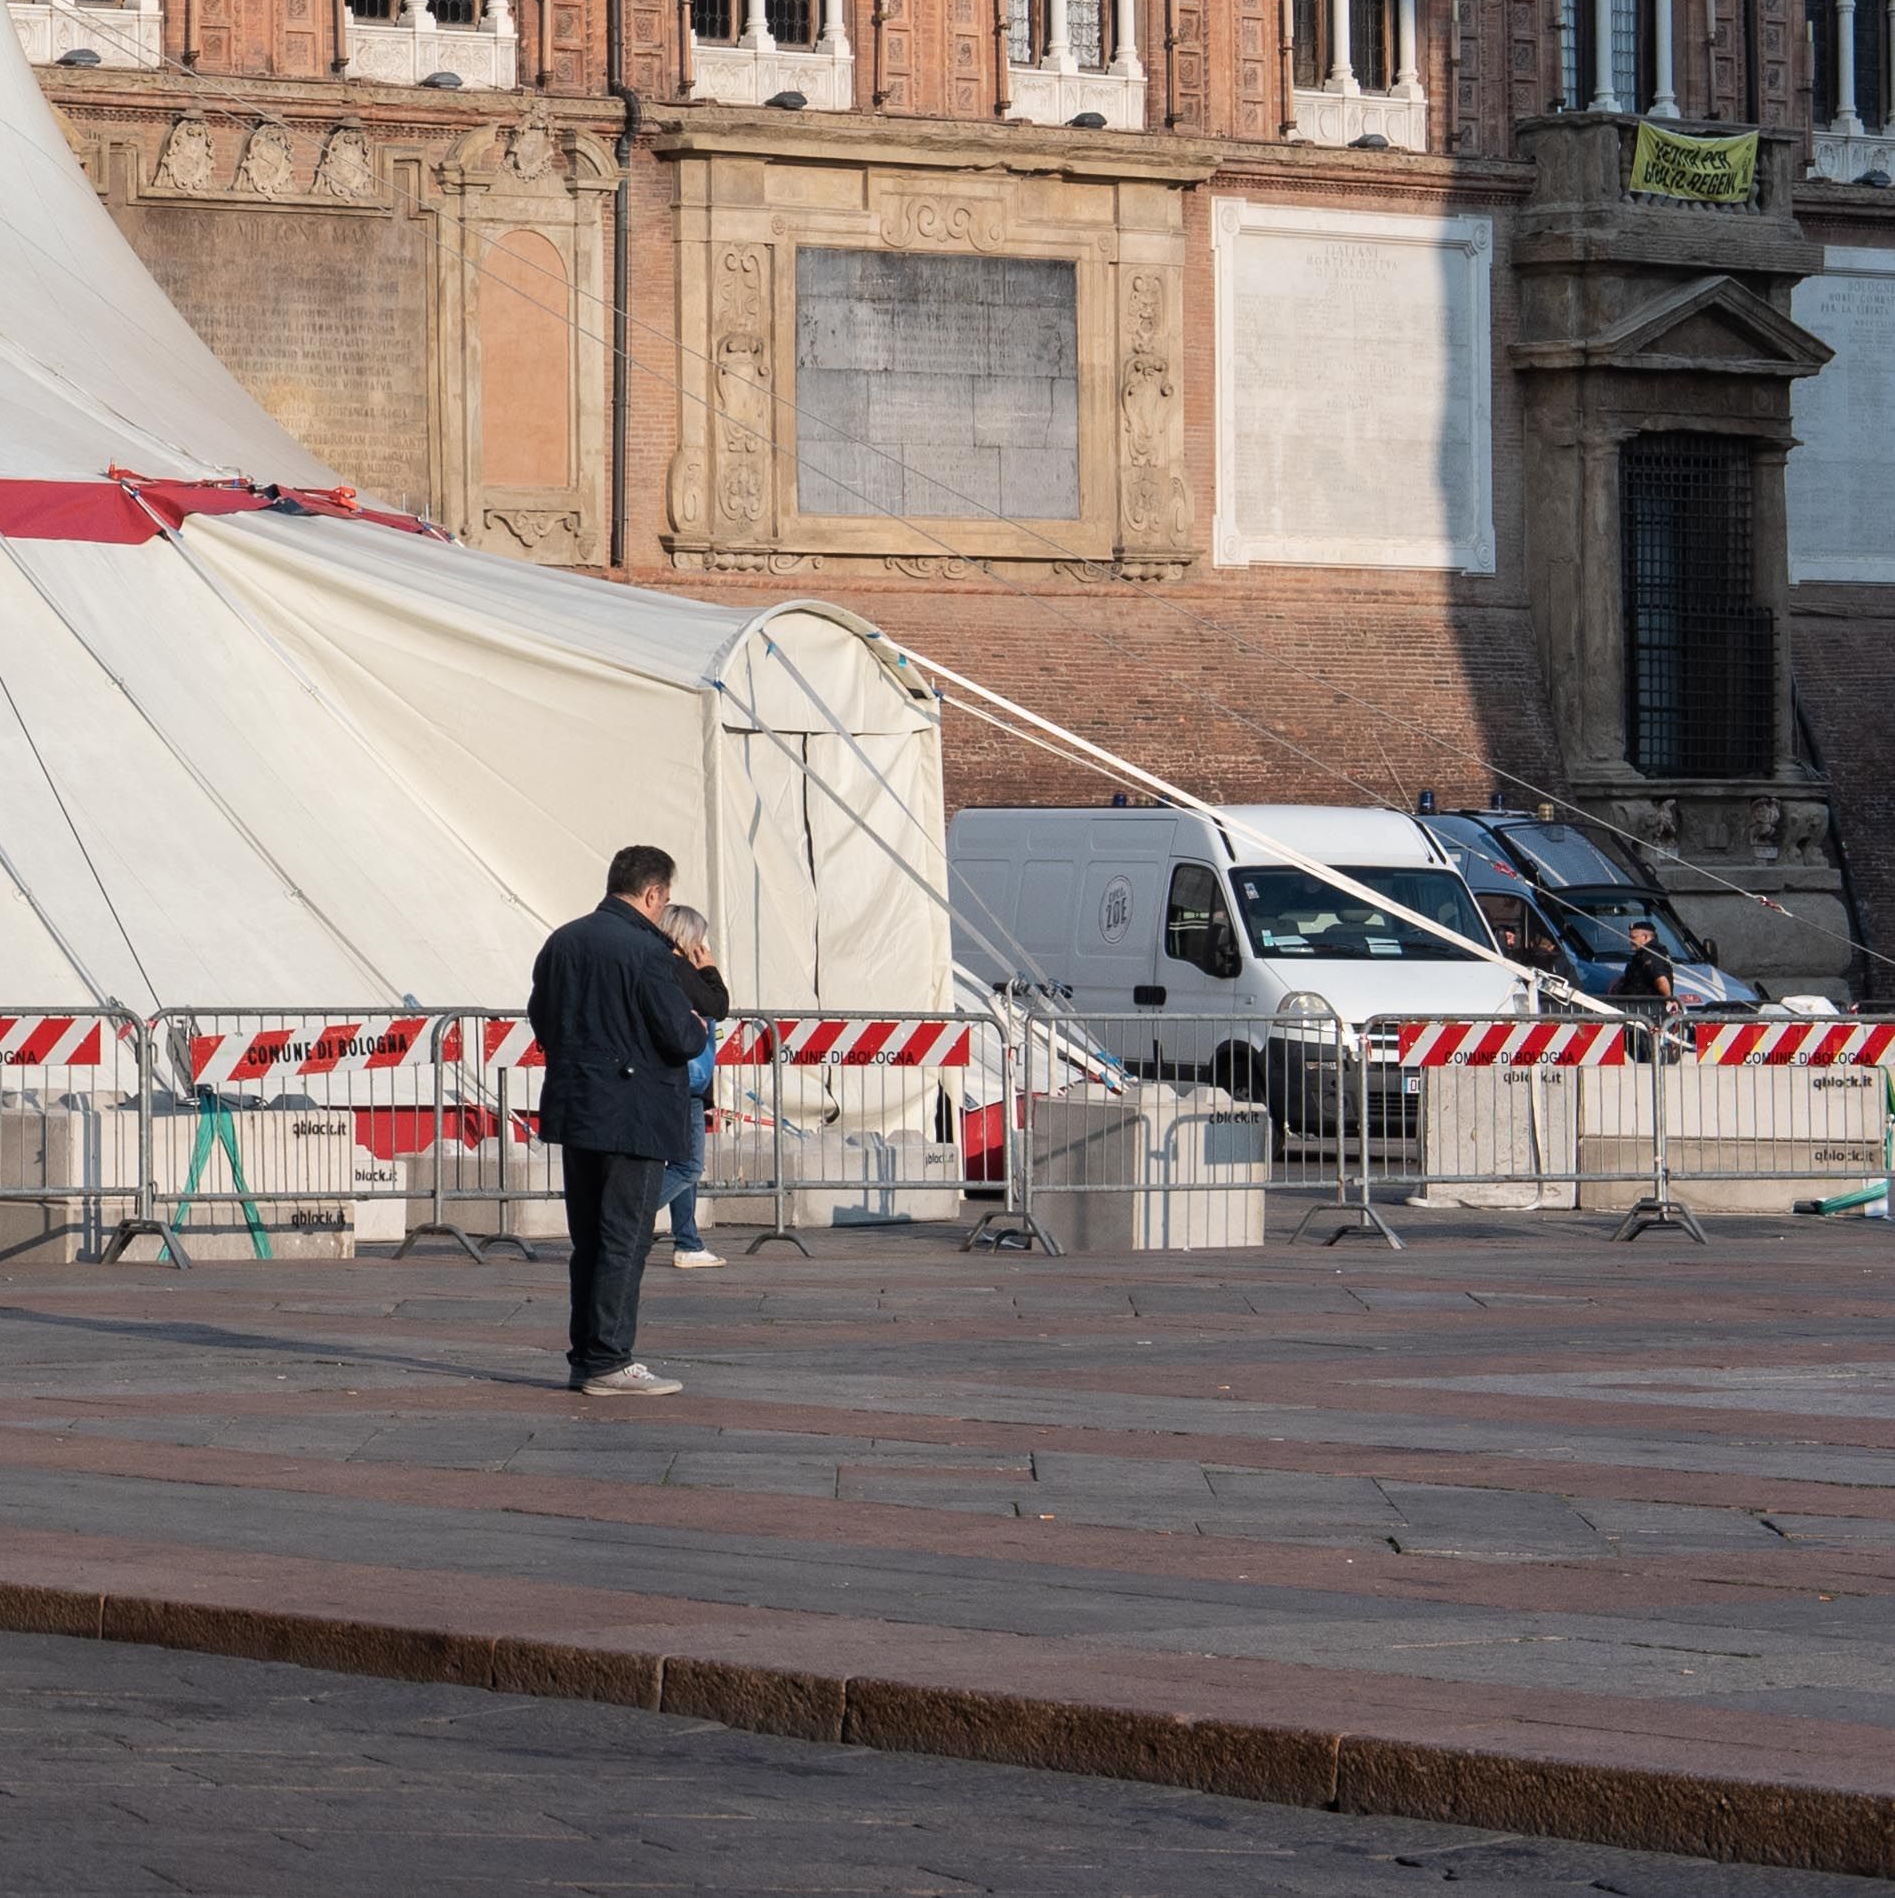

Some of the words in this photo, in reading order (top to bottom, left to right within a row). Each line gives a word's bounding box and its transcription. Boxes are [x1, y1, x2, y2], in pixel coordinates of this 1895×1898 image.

[1701, 149, 1732, 171] PER
[1686, 171, 1738, 196] REGENI
[246, 1042, 312, 1066] COMUNE
[316, 1040, 334, 1060] DI
[337, 1032, 408, 1059] BOLOGNA
[831, 1050, 844, 1064] DI
[847, 1050, 915, 1065] BOLOGNA
[1444, 1051, 1498, 1065] COMUNE
[1500, 1051, 1512, 1065] DI
[1514, 1051, 1574, 1065] BOLOGNA
[1743, 1051, 1796, 1066] COMUNE
[1799, 1051, 1810, 1065] DI
[1813, 1051, 1873, 1066] BOLOGNA
[1812, 1075, 1873, 1091] qblock.it
[292, 1120, 347, 1140] qblock.it
[1814, 1148, 1874, 1163] qblock.it
[291, 1209, 347, 1228] qblock.it
